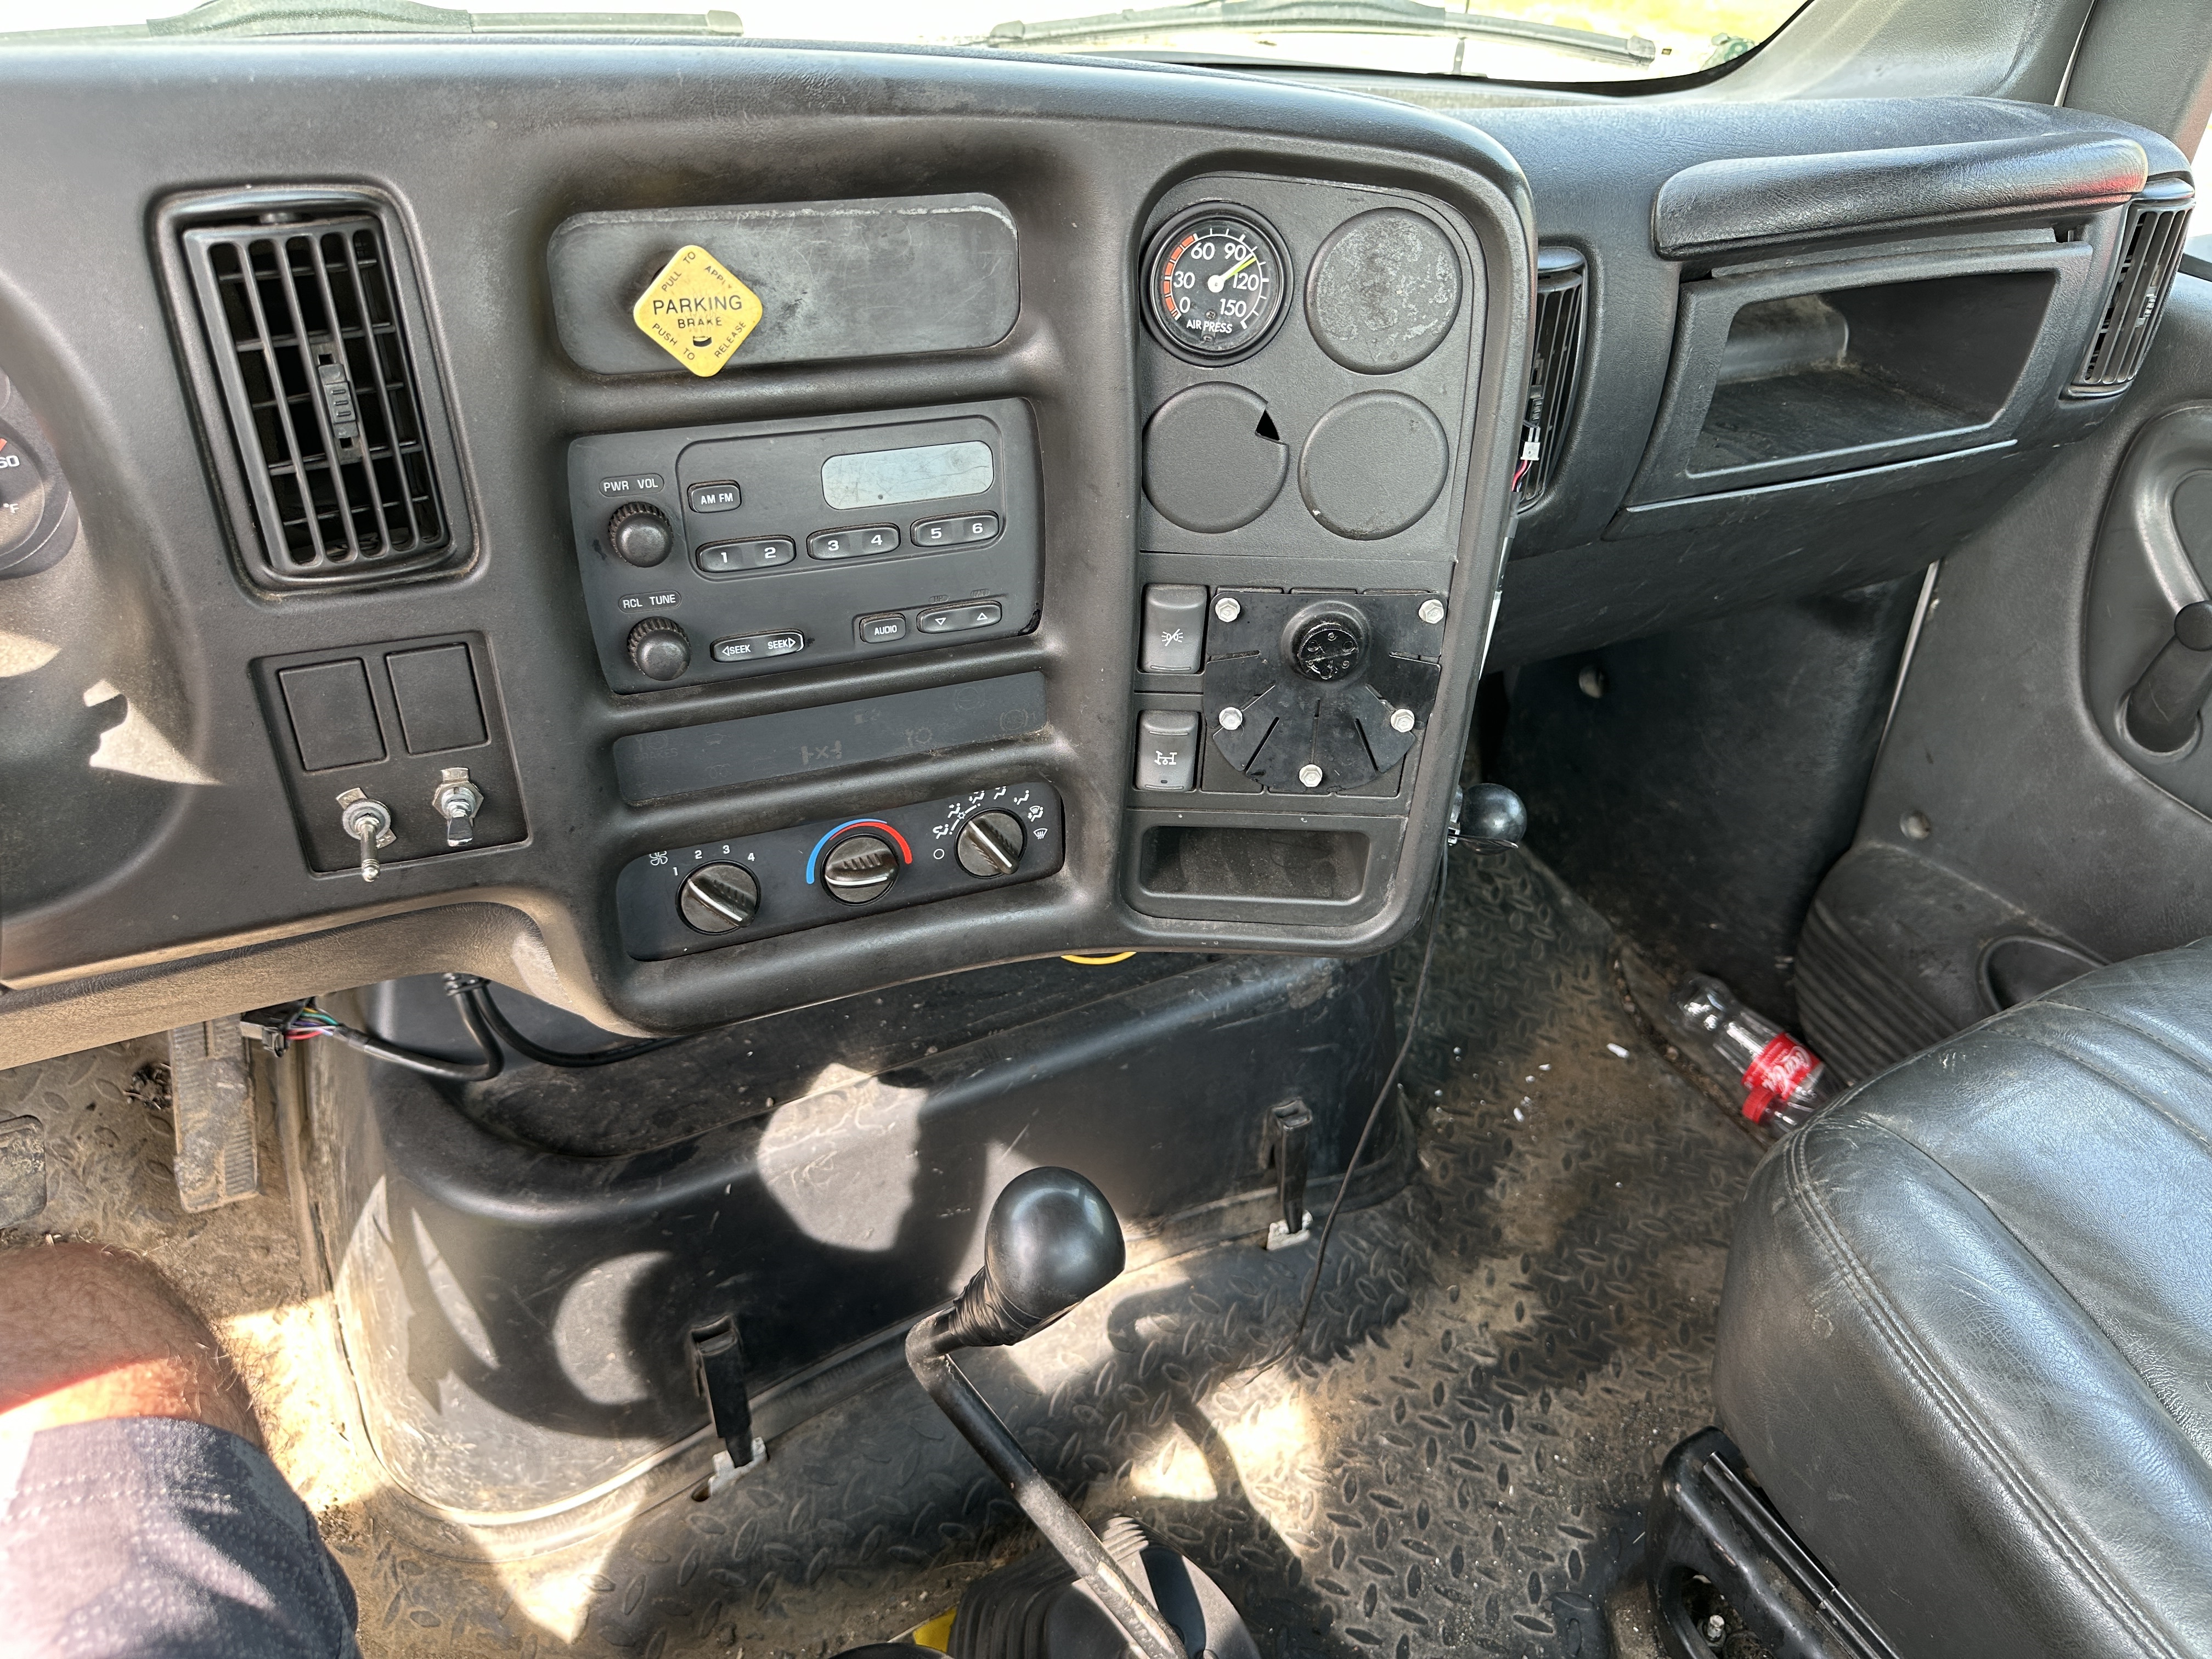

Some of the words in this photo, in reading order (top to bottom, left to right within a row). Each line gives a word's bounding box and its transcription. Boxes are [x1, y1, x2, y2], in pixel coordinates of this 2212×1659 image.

[1190, 243, 1215, 260] 60
[1224, 243, 1246, 261] 90
[662, 272, 681, 291] PULL
[683, 252, 696, 263] TO
[1173, 272, 1195, 289] 30
[1233, 273, 1259, 291] 120
[653, 295, 742, 315] PARKING
[1180, 296, 1190, 313] 0
[1220, 298, 1246, 317] 150
[678, 317, 722, 329] BRAKE
[1187, 320, 1201, 329] AIR
[1204, 321, 1232, 333] PRESS
[652, 323, 677, 346] PUSH
[683, 348, 695, 360] TO
[714, 321, 746, 358] RELEASE
[603, 481, 629, 491] PWR
[637, 478, 658, 489] VOL
[701, 495, 715, 505] AM
[719, 493, 733, 503] FM
[721, 552, 729, 563] 1
[764, 547, 776, 558] 2
[828, 540, 839, 551] 3
[871, 535, 882, 545] 4
[931, 528, 942, 539] 5
[973, 523, 983, 533] 6
[623, 599, 642, 609] RCL
[649, 594, 676, 606] TUNE
[874, 625, 897, 635] AUDIO
[730, 644, 751, 655] SEEK
[768, 639, 788, 650] SEEK
[673, 867, 678, 876] 1
[695, 850, 702, 859] 2
[723, 845, 730, 854] 3
[748, 853, 755, 862] 4
